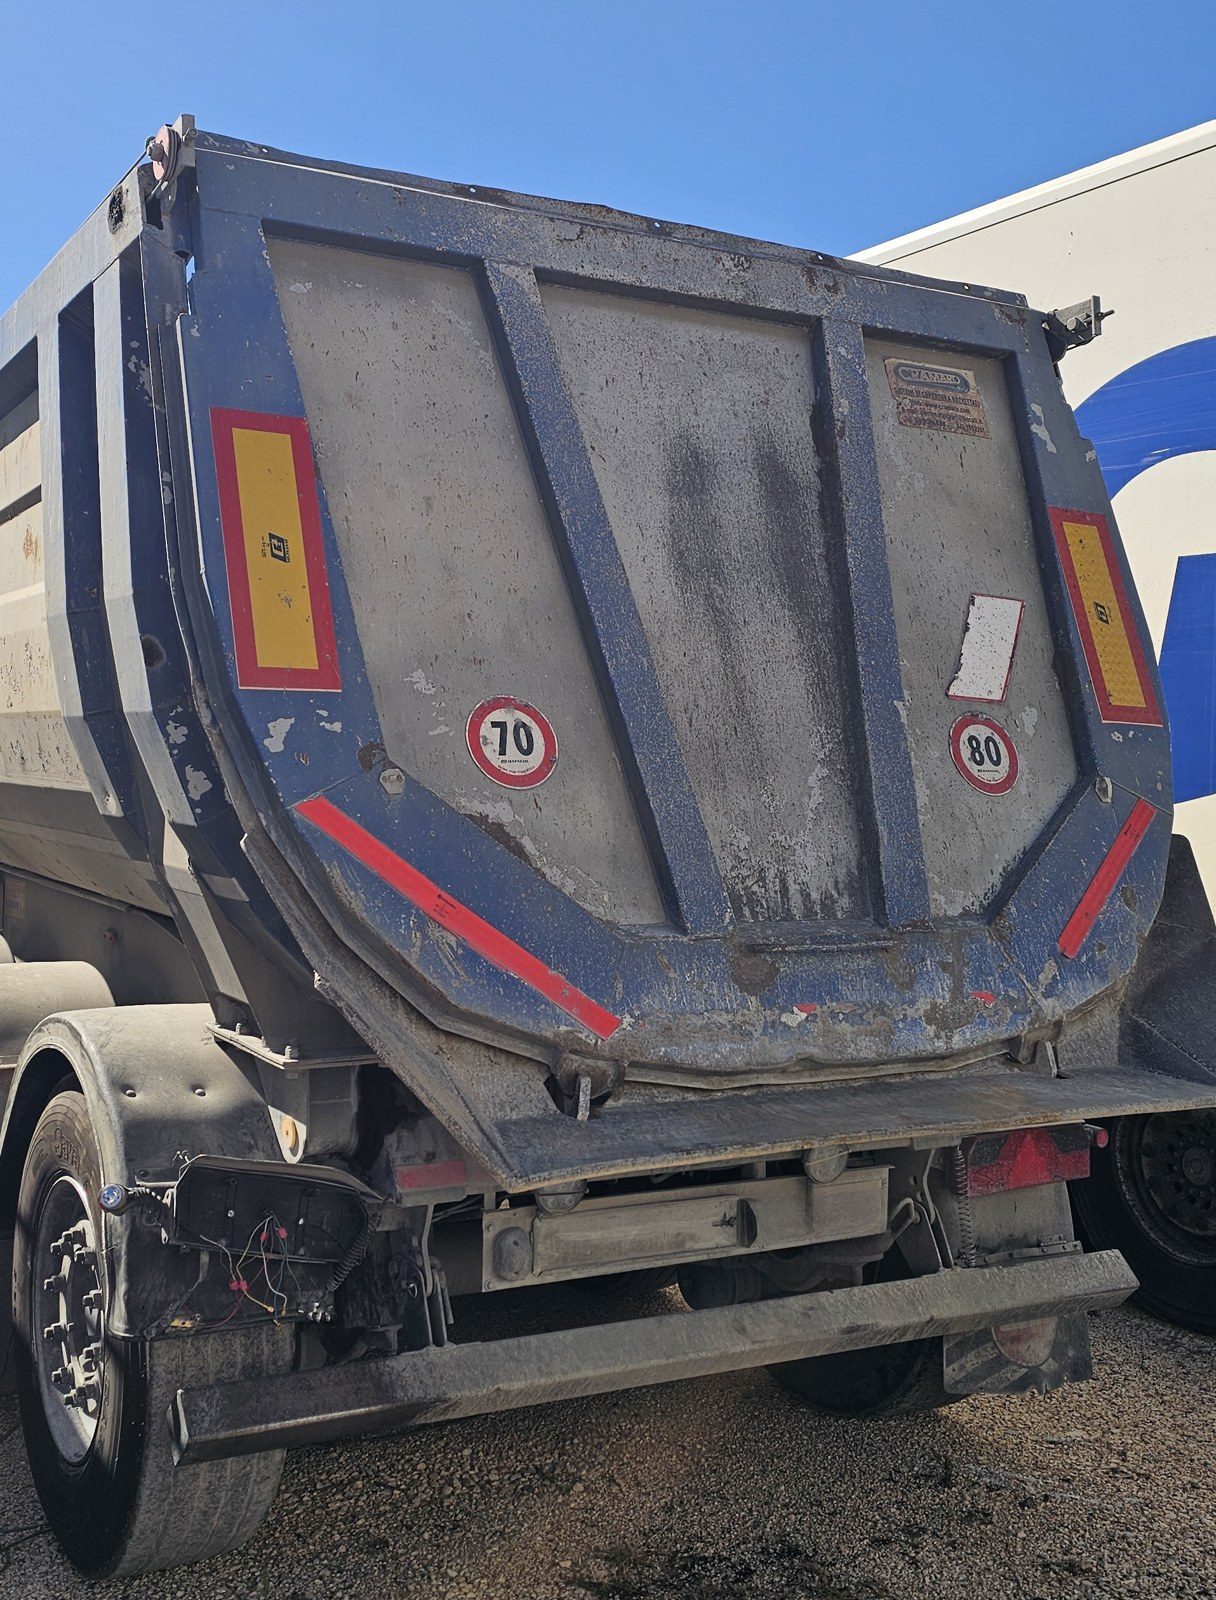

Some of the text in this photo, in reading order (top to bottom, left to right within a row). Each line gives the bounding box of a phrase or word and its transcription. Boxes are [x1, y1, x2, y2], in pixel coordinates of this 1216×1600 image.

[898, 366, 961, 383] CRAMARO
[490, 720, 534, 756] 70
[968, 735, 1001, 766] 80
